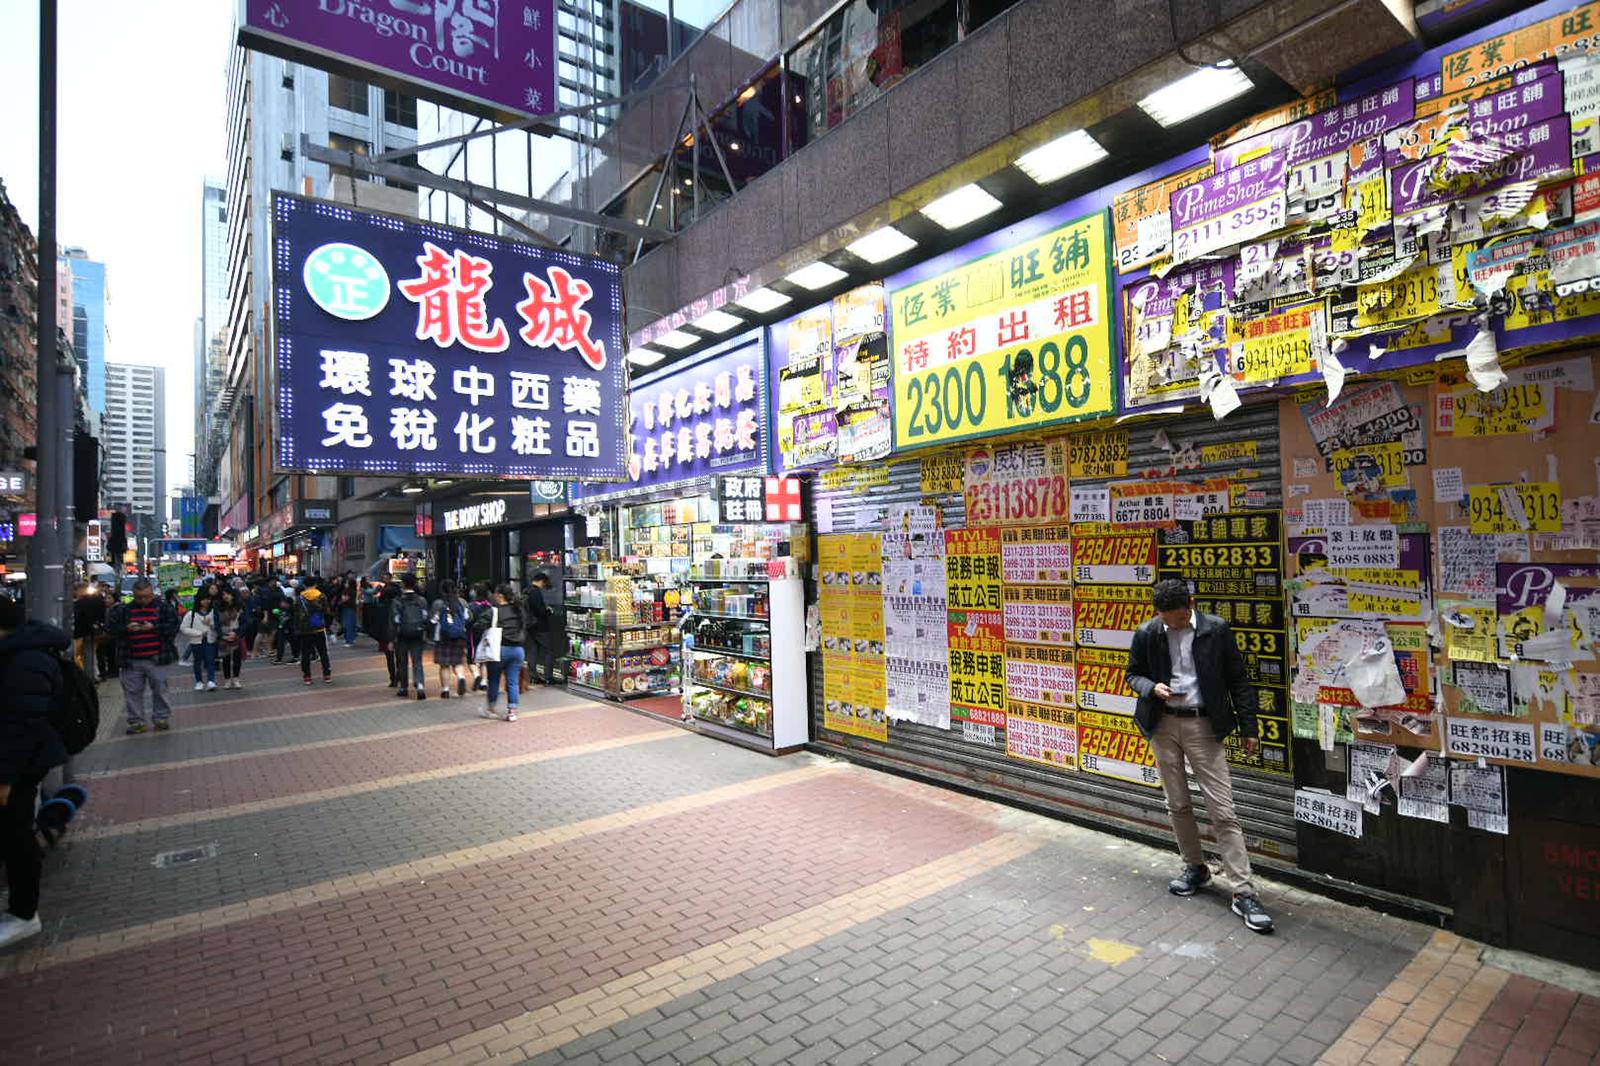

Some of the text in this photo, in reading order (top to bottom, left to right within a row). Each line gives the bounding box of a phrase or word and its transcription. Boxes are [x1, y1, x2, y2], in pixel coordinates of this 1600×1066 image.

[409, 43, 489, 85] Court
[1286, 114, 1388, 162] PrimeShop
[1176, 180, 1265, 223] PrimeShop
[1178, 197, 1282, 249] 2111 3555
[398, 241, 606, 371] 龍城
[903, 290, 1093, 372] 特約出租
[1245, 339, 1310, 373] 93419313
[319, 349, 602, 417] 環球中西藥
[907, 361, 987, 438] 2300
[321, 402, 601, 458] 免稅化粧品
[1070, 444, 1127, 463] 9782 8882
[724, 476, 762, 498] 政府
[968, 474, 1067, 521] 23113878
[443, 499, 505, 532] THE BODY SHOP
[724, 499, 763, 522] 註冊
[1116, 507, 1170, 522] 6677 8804
[1472, 493, 1561, 523] 934313
[951, 530, 993, 541] TML
[948, 555, 1000, 580] 稅務申報
[1165, 546, 1272, 567] 23662833
[1331, 553, 1395, 565] 3695 0883
[948, 583, 1000, 609] 成立公司
[1079, 630, 1096, 644] 租
[950, 649, 1003, 680] 稅務申報
[951, 678, 1004, 709] 成立公司
[1079, 665, 1138, 697] 23841
[1081, 692, 1098, 707] 租
[1082, 755, 1100, 771] 租
[1451, 741, 1533, 761] 68280428
[1295, 811, 1357, 836] 68280428
[1296, 795, 1358, 823] 旺舖招租
